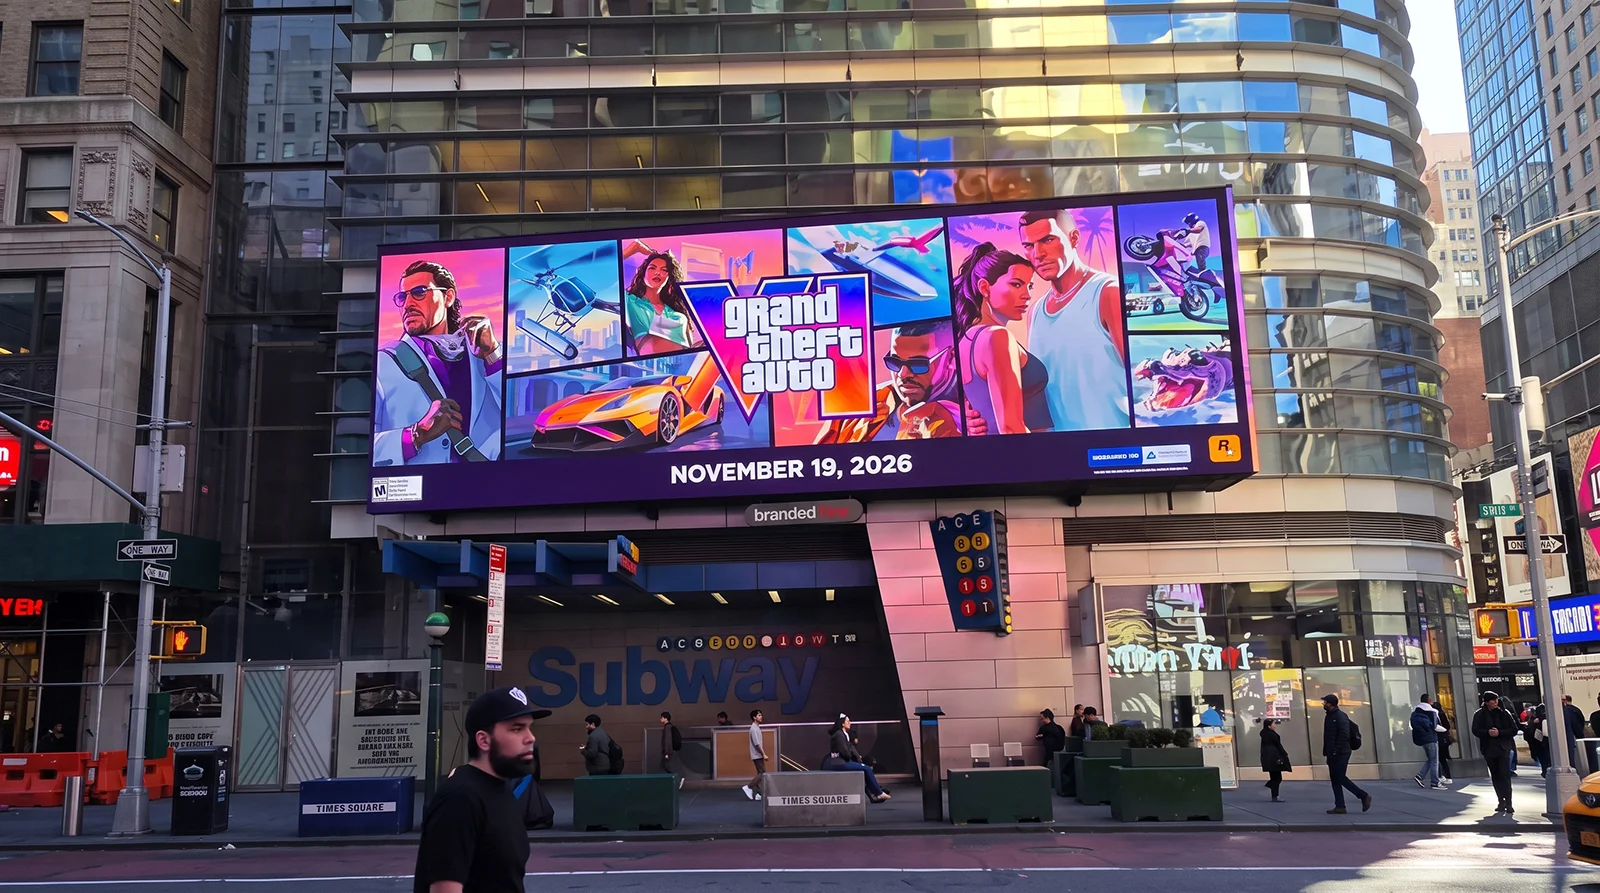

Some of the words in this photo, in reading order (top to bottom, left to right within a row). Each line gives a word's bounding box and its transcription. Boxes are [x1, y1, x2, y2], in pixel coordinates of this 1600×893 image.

[742, 358, 835, 394] auto
[1218, 439, 1229, 451] R
[670, 459, 804, 484] NOVEMBER
[811, 457, 843, 480] 19,
[850, 454, 913, 475] 2026
[374, 484, 386, 497] M
[754, 505, 816, 521] branded
[938, 520, 946, 531] A
[954, 517, 963, 528] C
[972, 514, 981, 526] E
[126, 546, 143, 555] ONE
[151, 545, 169, 554] WAY
[1510, 541, 1526, 549] ONE
[978, 557, 985, 568] 5
[982, 601, 988, 613] T
[661, 640, 669, 649] A
[678, 639, 686, 648] C
[831, 634, 839, 644] T
[525, 646, 820, 715] Subway
[781, 796, 810, 804] TIMES
[812, 796, 848, 804] SQUARE
[316, 804, 345, 813] TIMES
[347, 803, 384, 812] SQUARE
